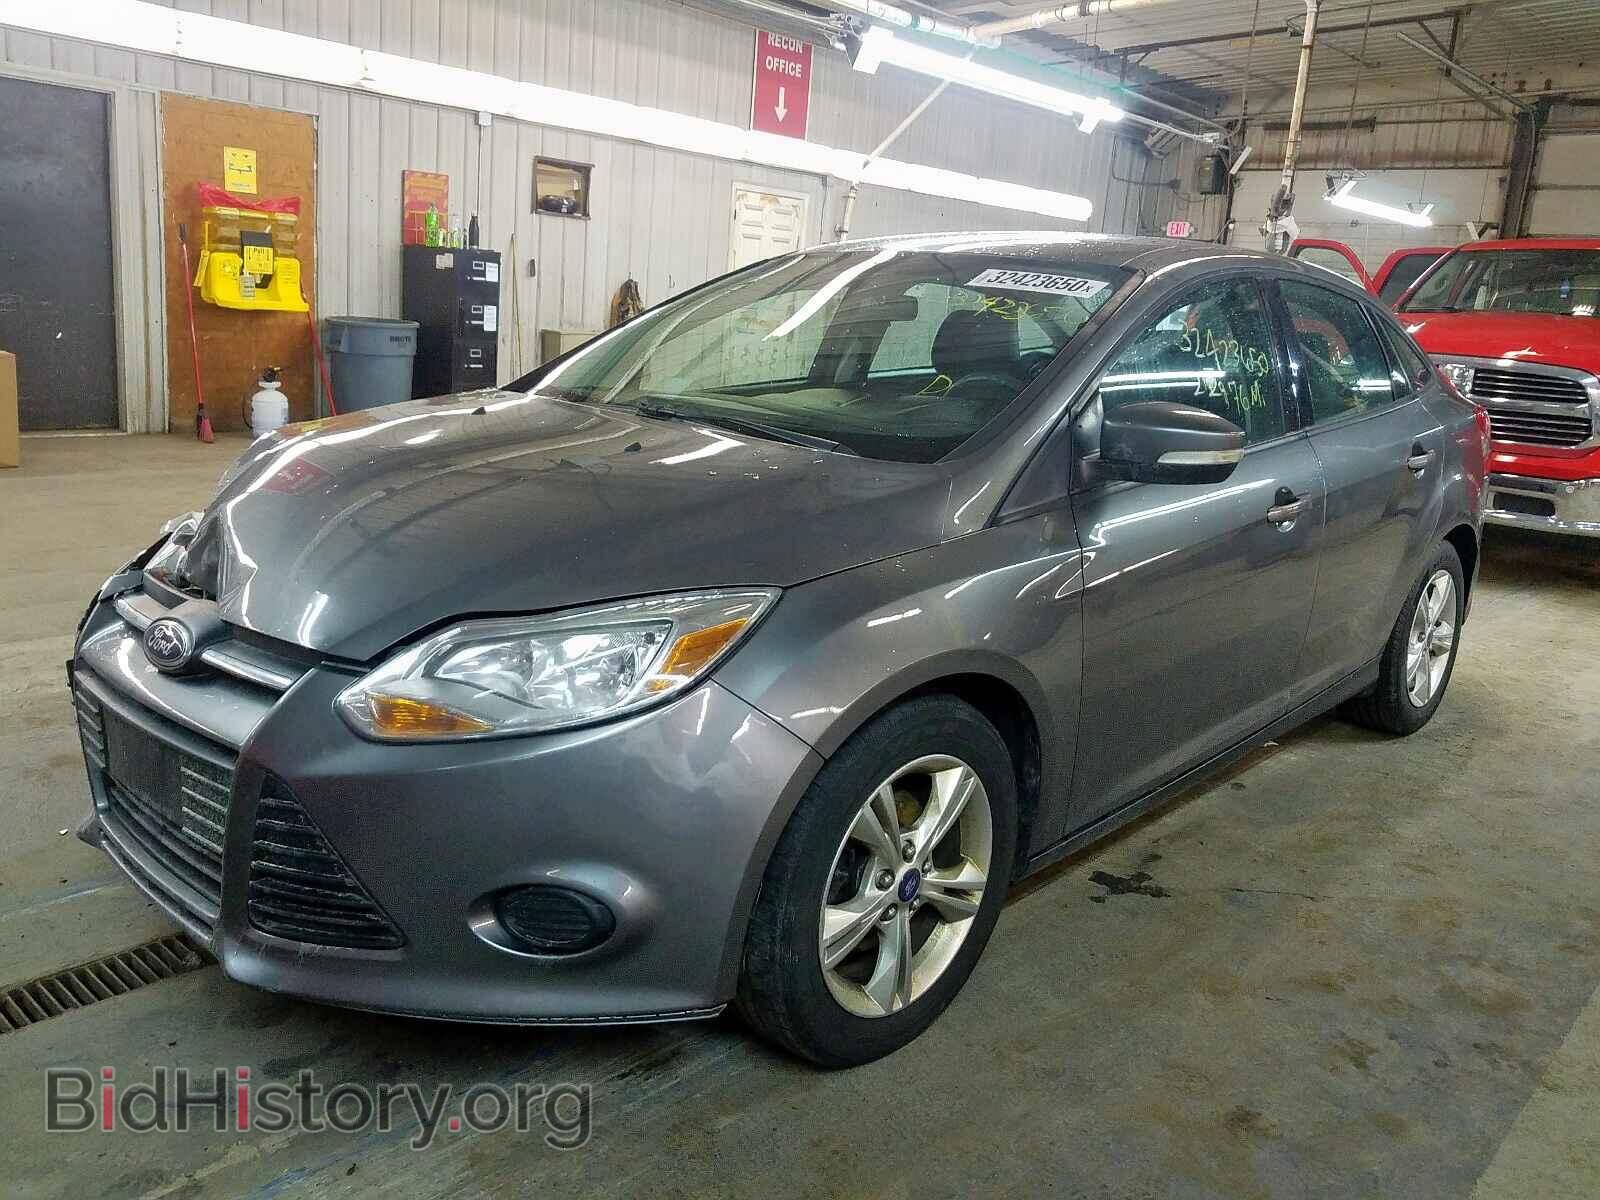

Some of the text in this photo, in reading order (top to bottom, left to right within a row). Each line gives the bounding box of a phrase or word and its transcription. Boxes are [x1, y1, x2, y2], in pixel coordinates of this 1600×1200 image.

[767, 31, 803, 53] RECON
[766, 55, 802, 78] OFFICE
[1170, 222, 1186, 235] EXIT
